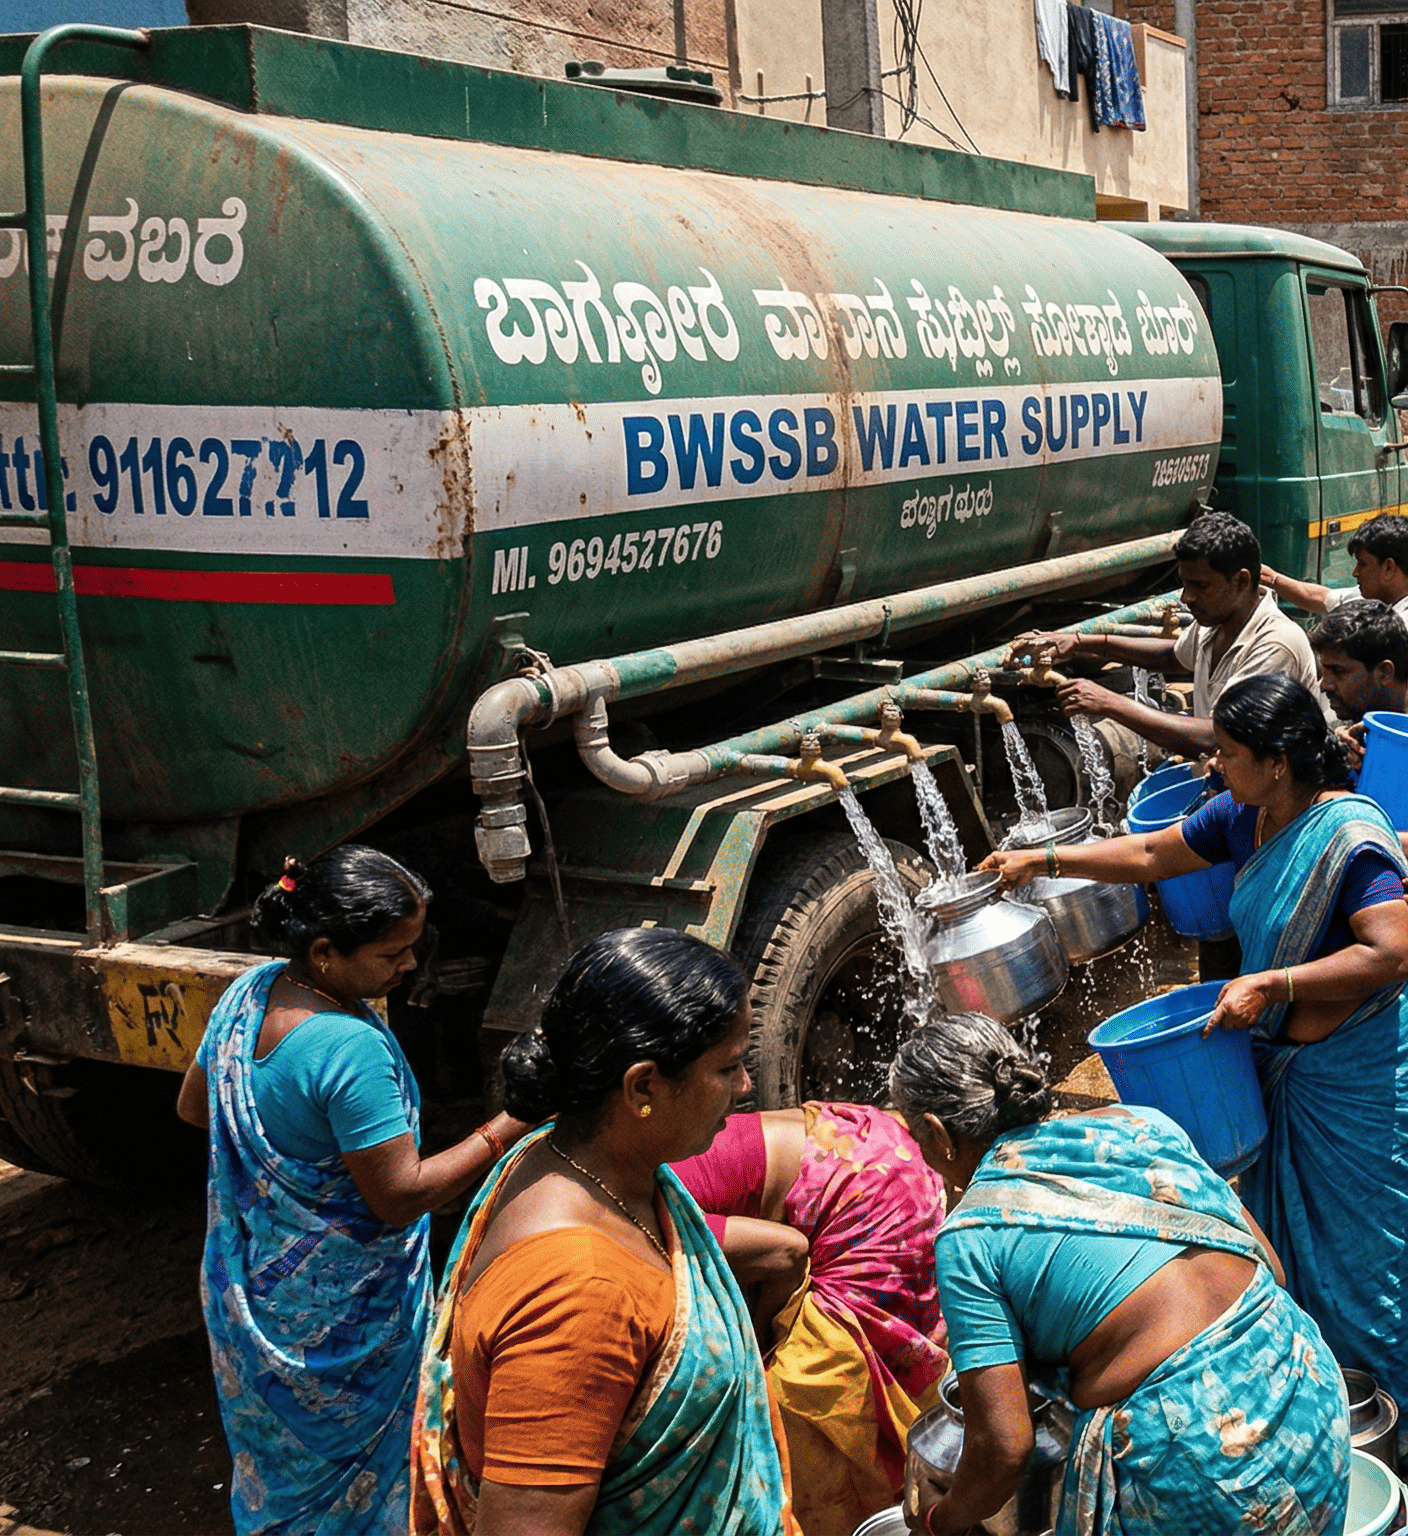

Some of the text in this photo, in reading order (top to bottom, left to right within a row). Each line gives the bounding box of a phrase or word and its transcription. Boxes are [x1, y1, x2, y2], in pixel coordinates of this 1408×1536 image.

[622, 390, 1149, 497] BWSSB WATER SUPPLY
[547, 520, 724, 586] 9694527676
